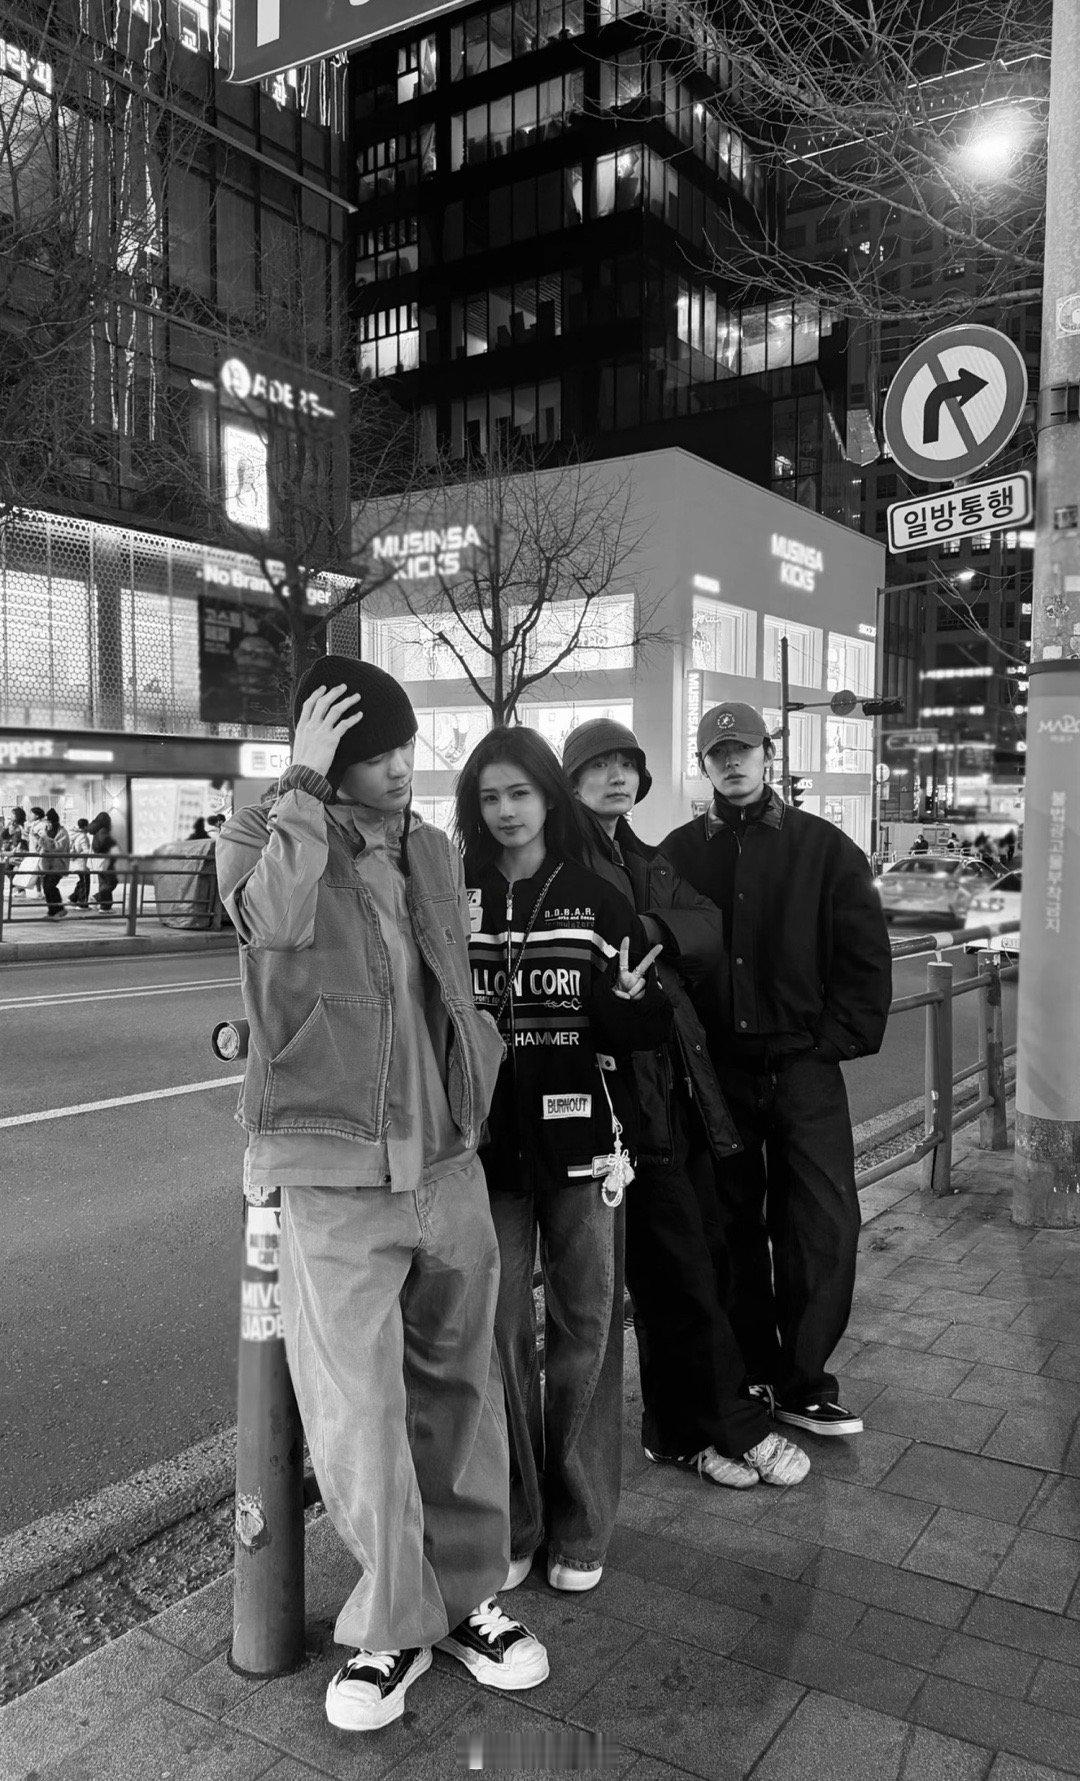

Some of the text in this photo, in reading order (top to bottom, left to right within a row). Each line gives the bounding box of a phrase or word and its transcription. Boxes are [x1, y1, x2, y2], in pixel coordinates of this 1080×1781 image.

[904, 485, 1014, 540] 일방통행
[373, 523, 480, 559] MUSINSA
[231, 568, 274, 595] Bran
[515, 1031, 580, 1047] HAMMER
